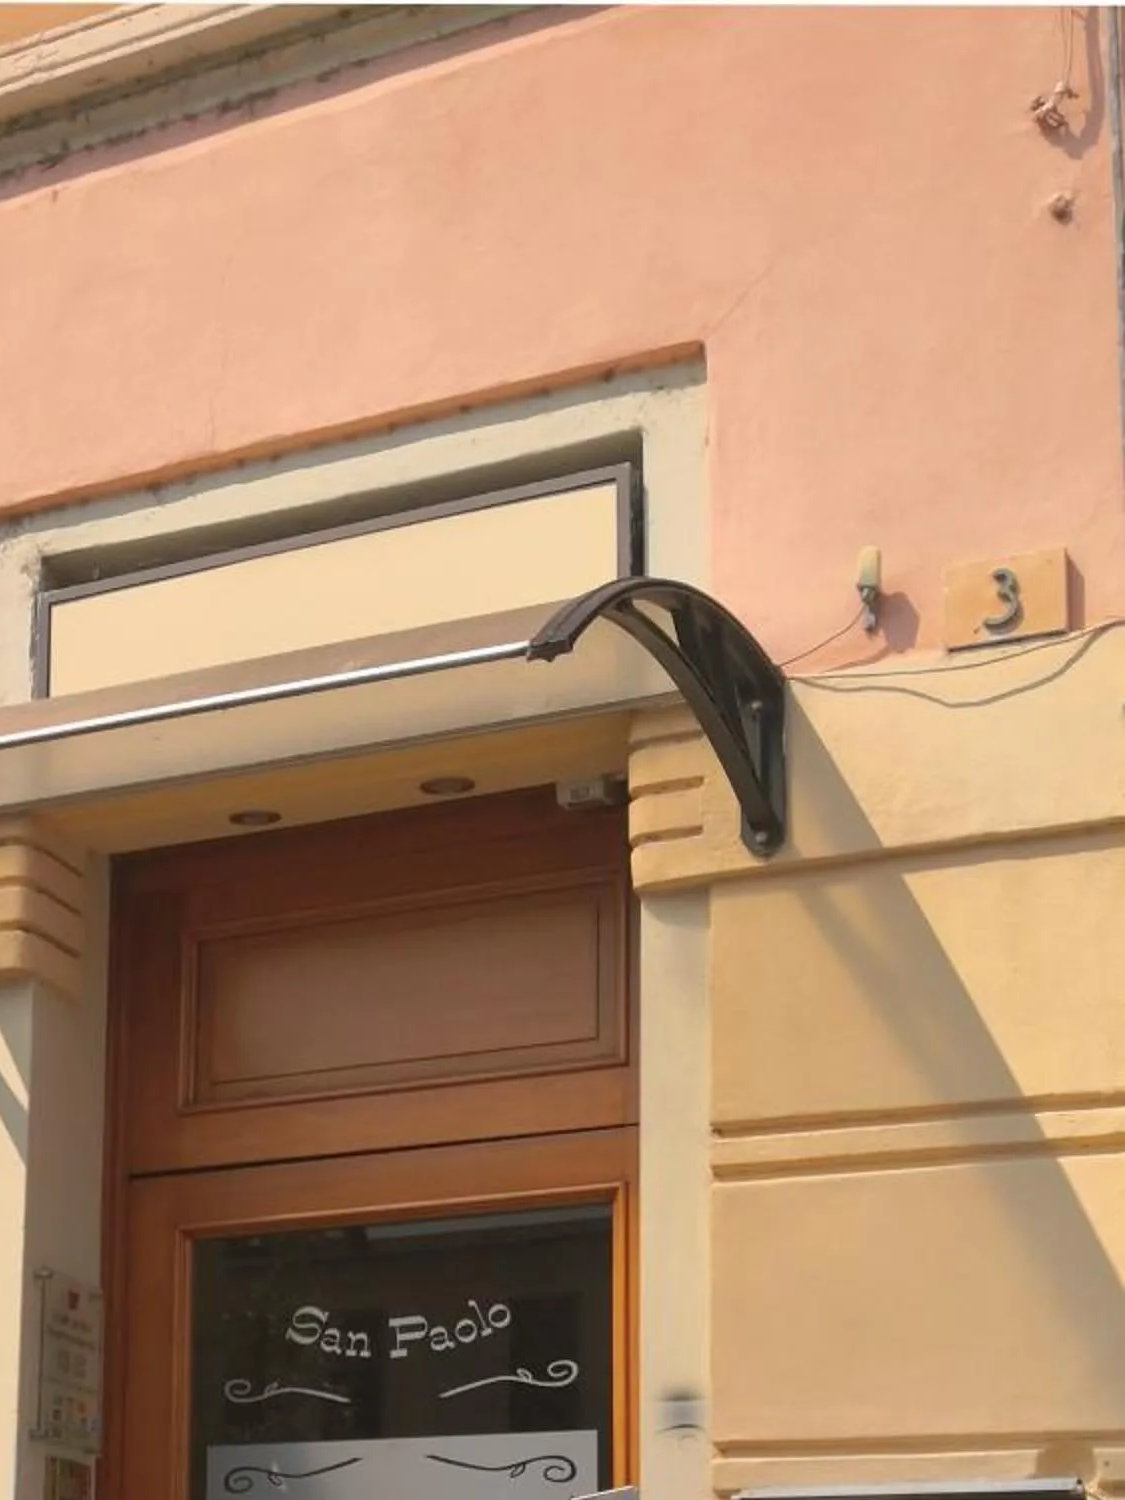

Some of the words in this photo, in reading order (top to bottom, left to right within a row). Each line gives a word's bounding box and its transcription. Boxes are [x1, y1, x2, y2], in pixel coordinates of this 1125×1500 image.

[983, 567, 1020, 630] 3
[286, 1305, 371, 1357] San
[388, 1300, 512, 1358] Paolo
